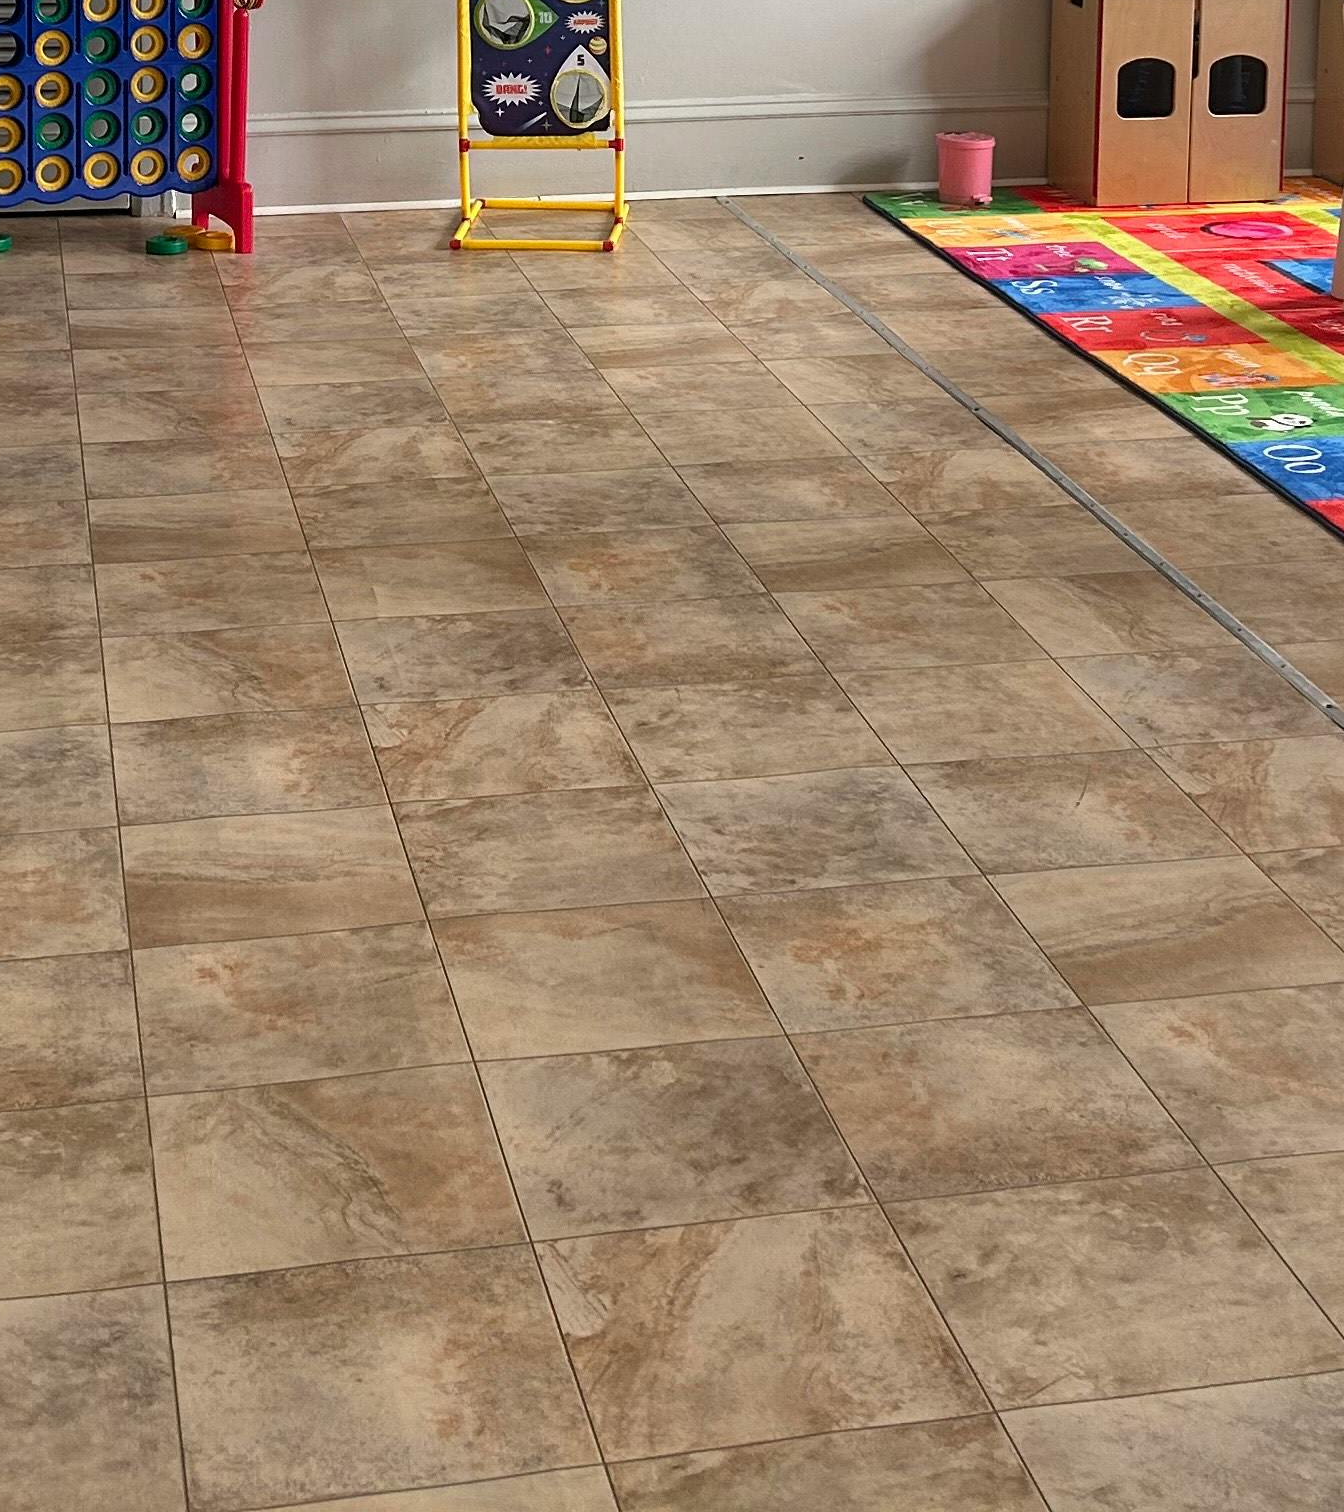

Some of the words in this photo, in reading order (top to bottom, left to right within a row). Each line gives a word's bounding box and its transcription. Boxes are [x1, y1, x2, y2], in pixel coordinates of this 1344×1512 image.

[538, 11, 553, 24] 10
[577, 54, 585, 66] 5
[1011, 279, 1058, 295] Ss
[1061, 314, 1114, 334] Rr
[1122, 351, 1184, 377] Qq
[1190, 392, 1250, 416] Pp
[1262, 444, 1328, 474] Oo
